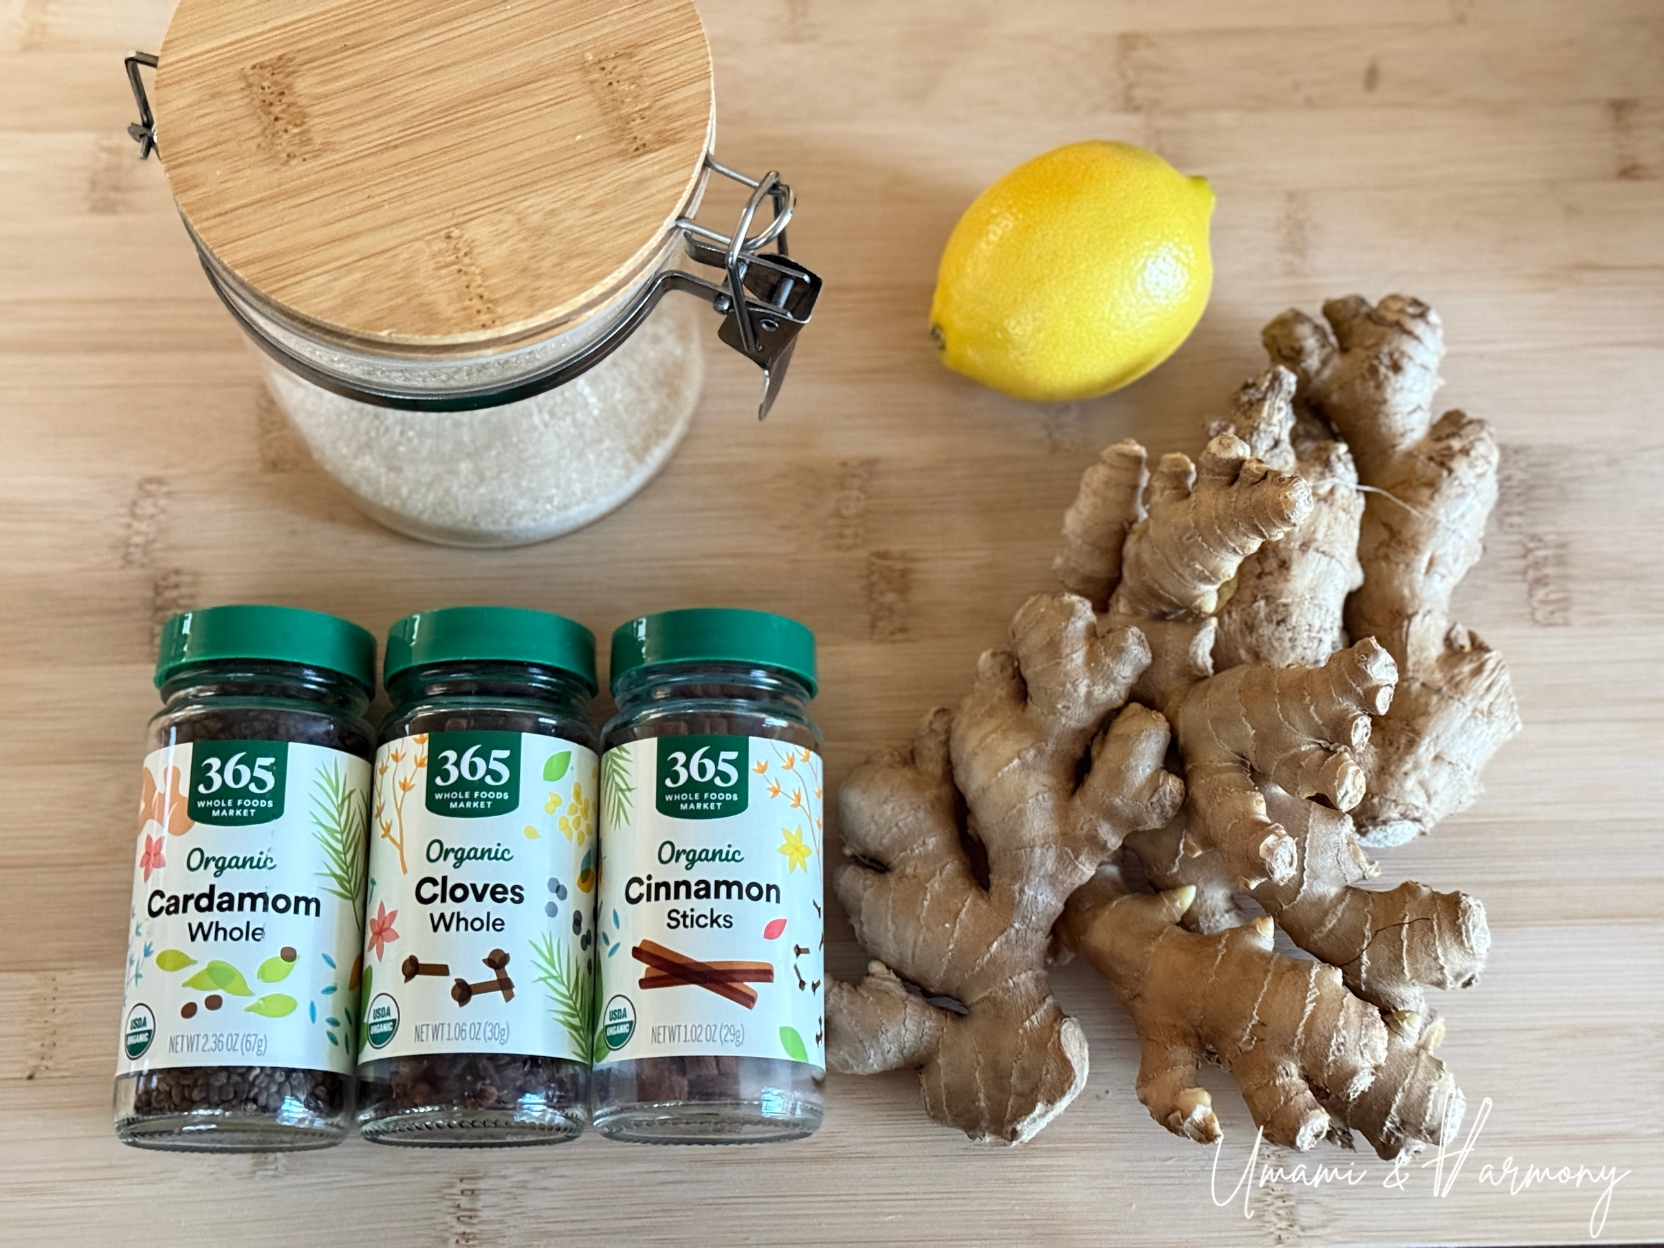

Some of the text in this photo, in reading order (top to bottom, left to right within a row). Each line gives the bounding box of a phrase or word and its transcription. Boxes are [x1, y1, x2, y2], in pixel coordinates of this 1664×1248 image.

[198, 752, 276, 794] 365
[435, 744, 510, 786] 365
[665, 746, 739, 788] 365
[197, 799, 273, 808] WHOLE FOODS
[665, 793, 738, 801] WHOLE FOODS
[212, 809, 256, 817] MARKET
[186, 847, 277, 877] Organic
[426, 839, 513, 869] Organic
[658, 841, 744, 870] Organic
[415, 875, 525, 905] Cloves
[625, 874, 781, 904] Cinnamon
[147, 884, 321, 918] Cardamom
[430, 912, 505, 933] Whole
[666, 908, 733, 929] Sticks
[188, 921, 265, 942] Whole
[130, 1016, 147, 1030] USDA
[373, 1006, 391, 1020] USDA
[609, 1008, 627, 1021] USDA
[127, 1031, 150, 1046] ORGANIC
[370, 1022, 394, 1035] ORGANIC
[414, 1021, 510, 1045] NET WT 1.06 OZ (30g)
[607, 1024, 630, 1036] ORGANIC
[651, 1023, 745, 1047] NET WT 1.02 OZ (29g)
[168, 1033, 268, 1057] NET WT 2.36 OZ (67g)
